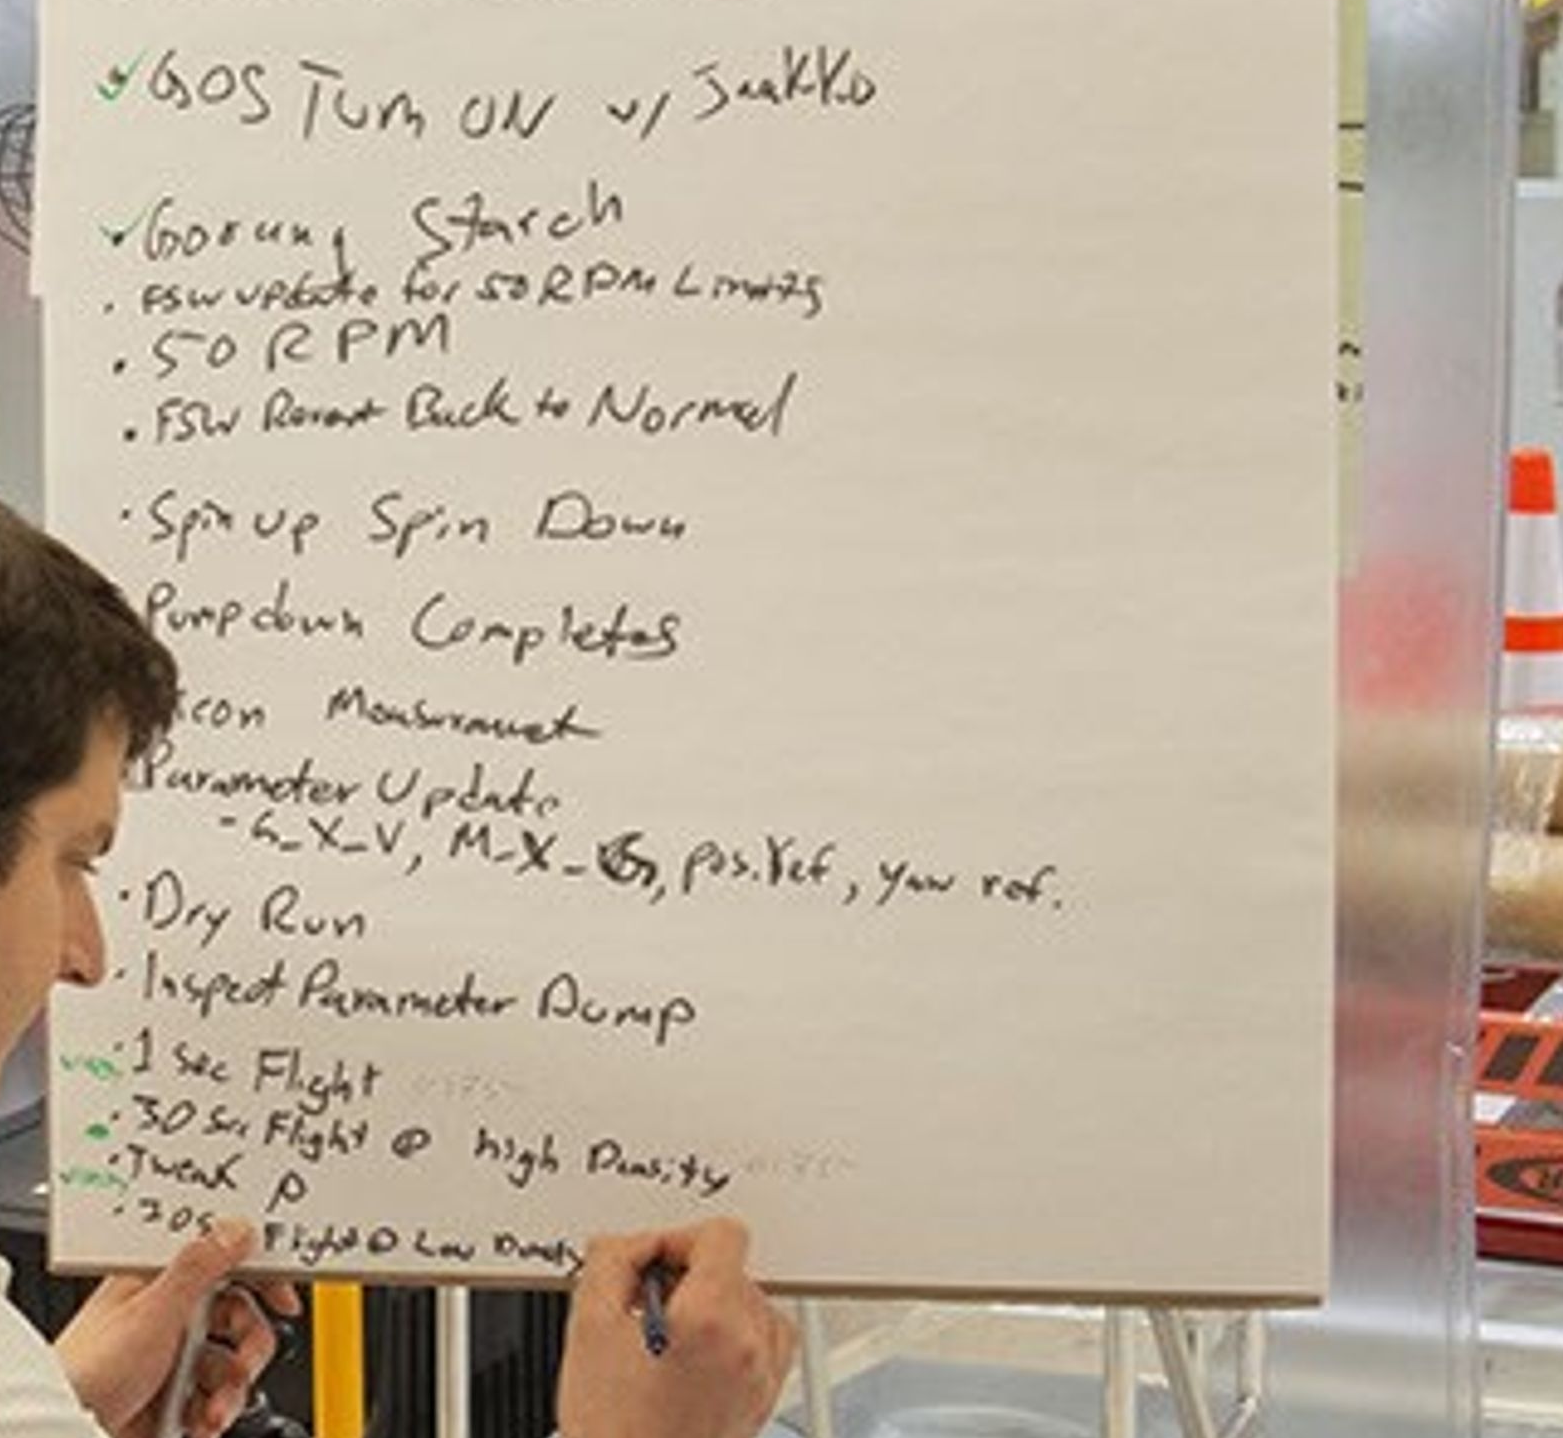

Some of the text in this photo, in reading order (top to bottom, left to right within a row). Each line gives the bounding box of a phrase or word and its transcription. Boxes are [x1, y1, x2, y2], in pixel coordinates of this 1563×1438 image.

[459, 89, 558, 140] ON
[152, 311, 451, 381] 50 RPM
[534, 386, 571, 420] to
[586, 371, 798, 438] Normal
[368, 490, 490, 560] Spin
[534, 489, 687, 541] Down
[143, 868, 367, 950] Dry Run
[537, 972, 697, 1047] Dump
[131, 1026, 153, 1075] 1
[253, 1047, 383, 1120] Flight
